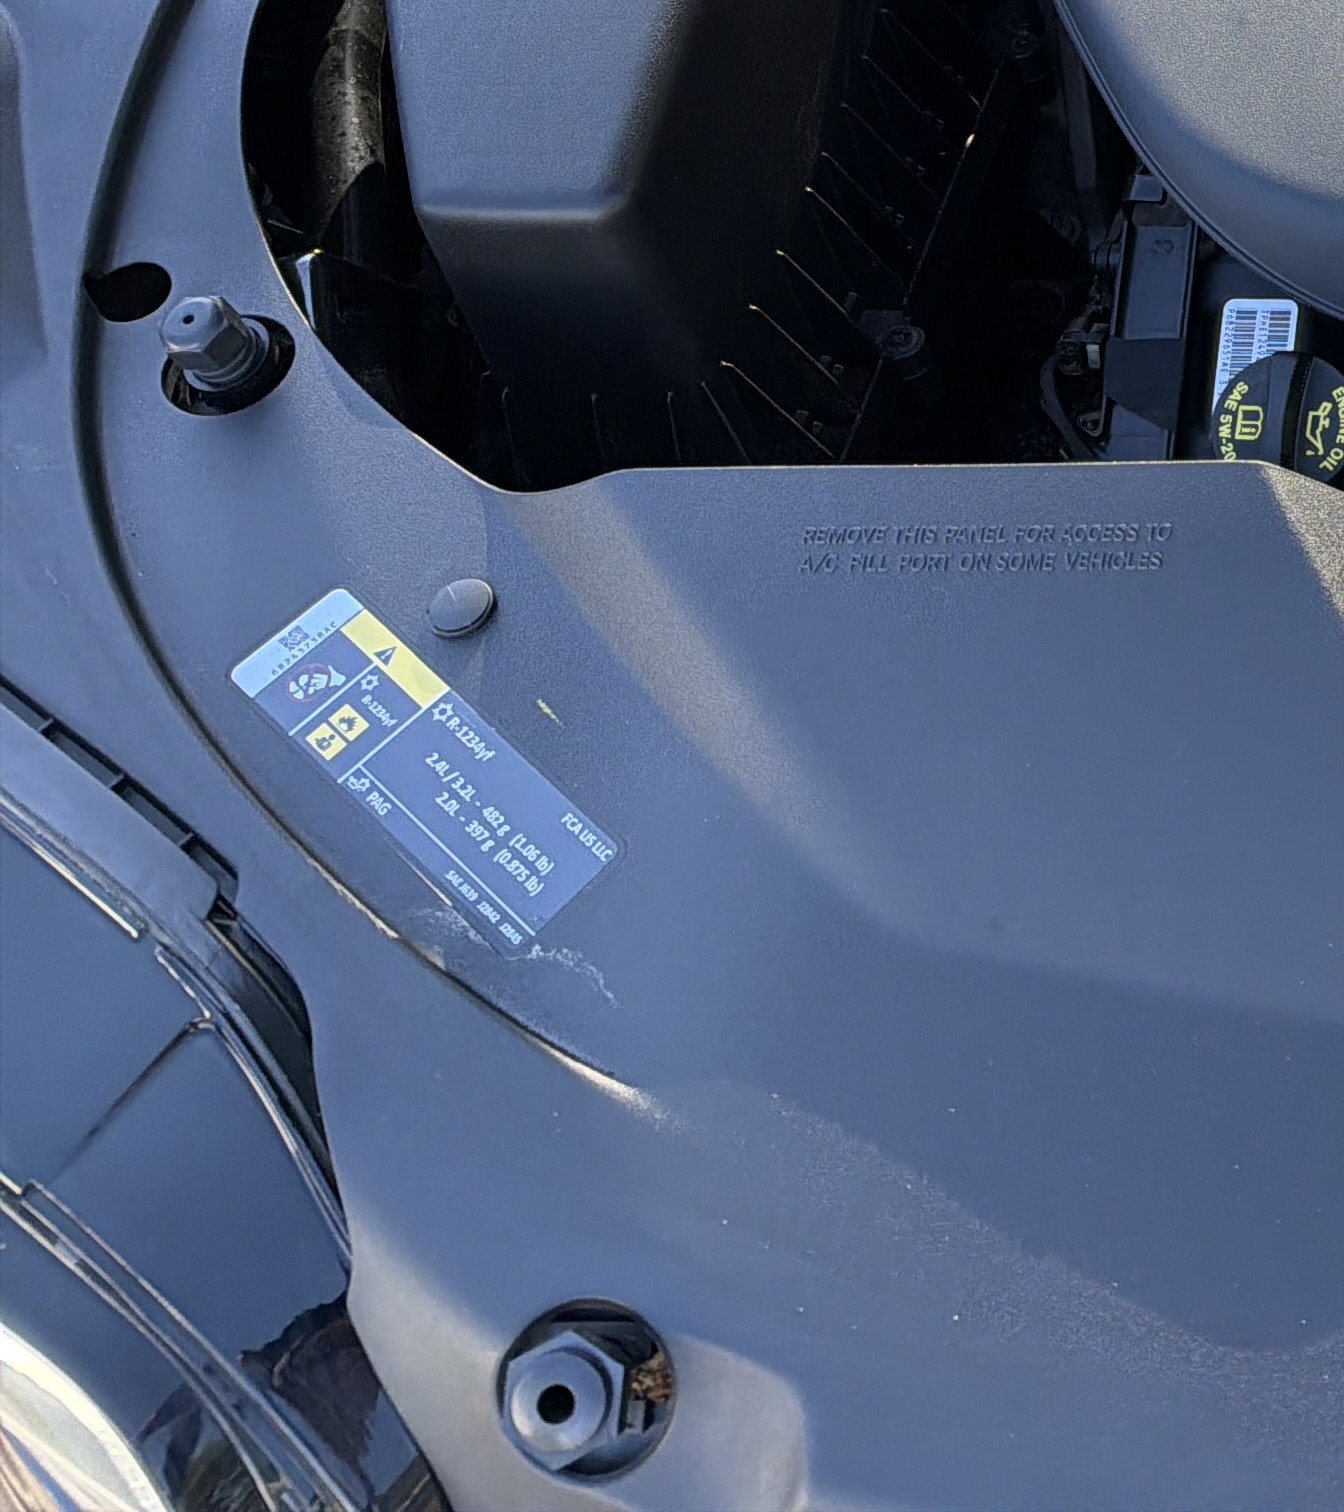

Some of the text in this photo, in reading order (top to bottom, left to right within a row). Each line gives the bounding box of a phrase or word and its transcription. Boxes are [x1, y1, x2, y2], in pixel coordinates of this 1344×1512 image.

[1218, 381, 1249, 462] SAE 5W-20
[1319, 447, 1344, 471] OIL
[801, 521, 1174, 545] REMOVE THIS PANEL FOR ACCESS TO
[800, 550, 1163, 573] A/C FILL PORT ON SOME VEHICLES
[443, 714, 495, 766] R-1234yf
[364, 790, 392, 818] PAG
[433, 789, 462, 818] 2.0L
[463, 818, 489, 845] 397
[491, 847, 530, 886] (0.875
[520, 874, 545, 899] lb)
[478, 803, 504, 829] 482
[507, 831, 541, 865] (1.06
[531, 854, 555, 878] lb)
[559, 811, 613, 863] FCA US LLC
